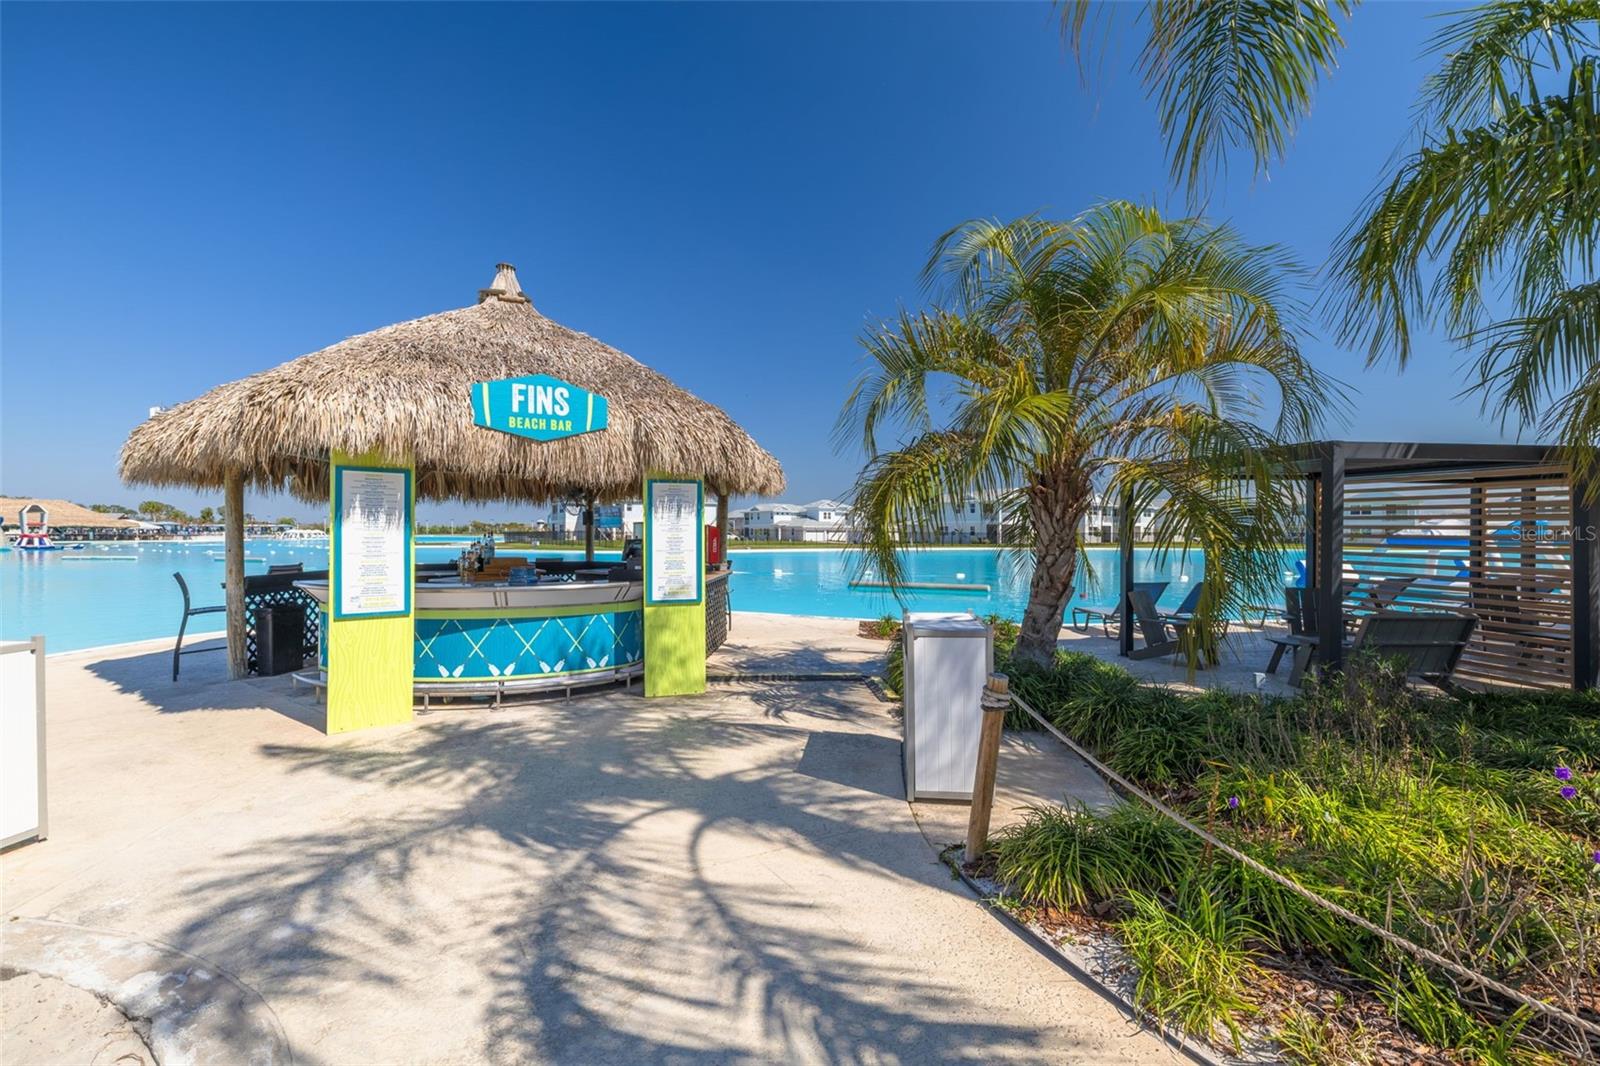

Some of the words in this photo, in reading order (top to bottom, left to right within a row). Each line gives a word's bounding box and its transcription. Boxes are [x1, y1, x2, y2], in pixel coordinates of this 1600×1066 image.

[511, 383, 570, 417] FINS
[508, 416, 547, 430] BEACH
[550, 418, 572, 432] BAR
